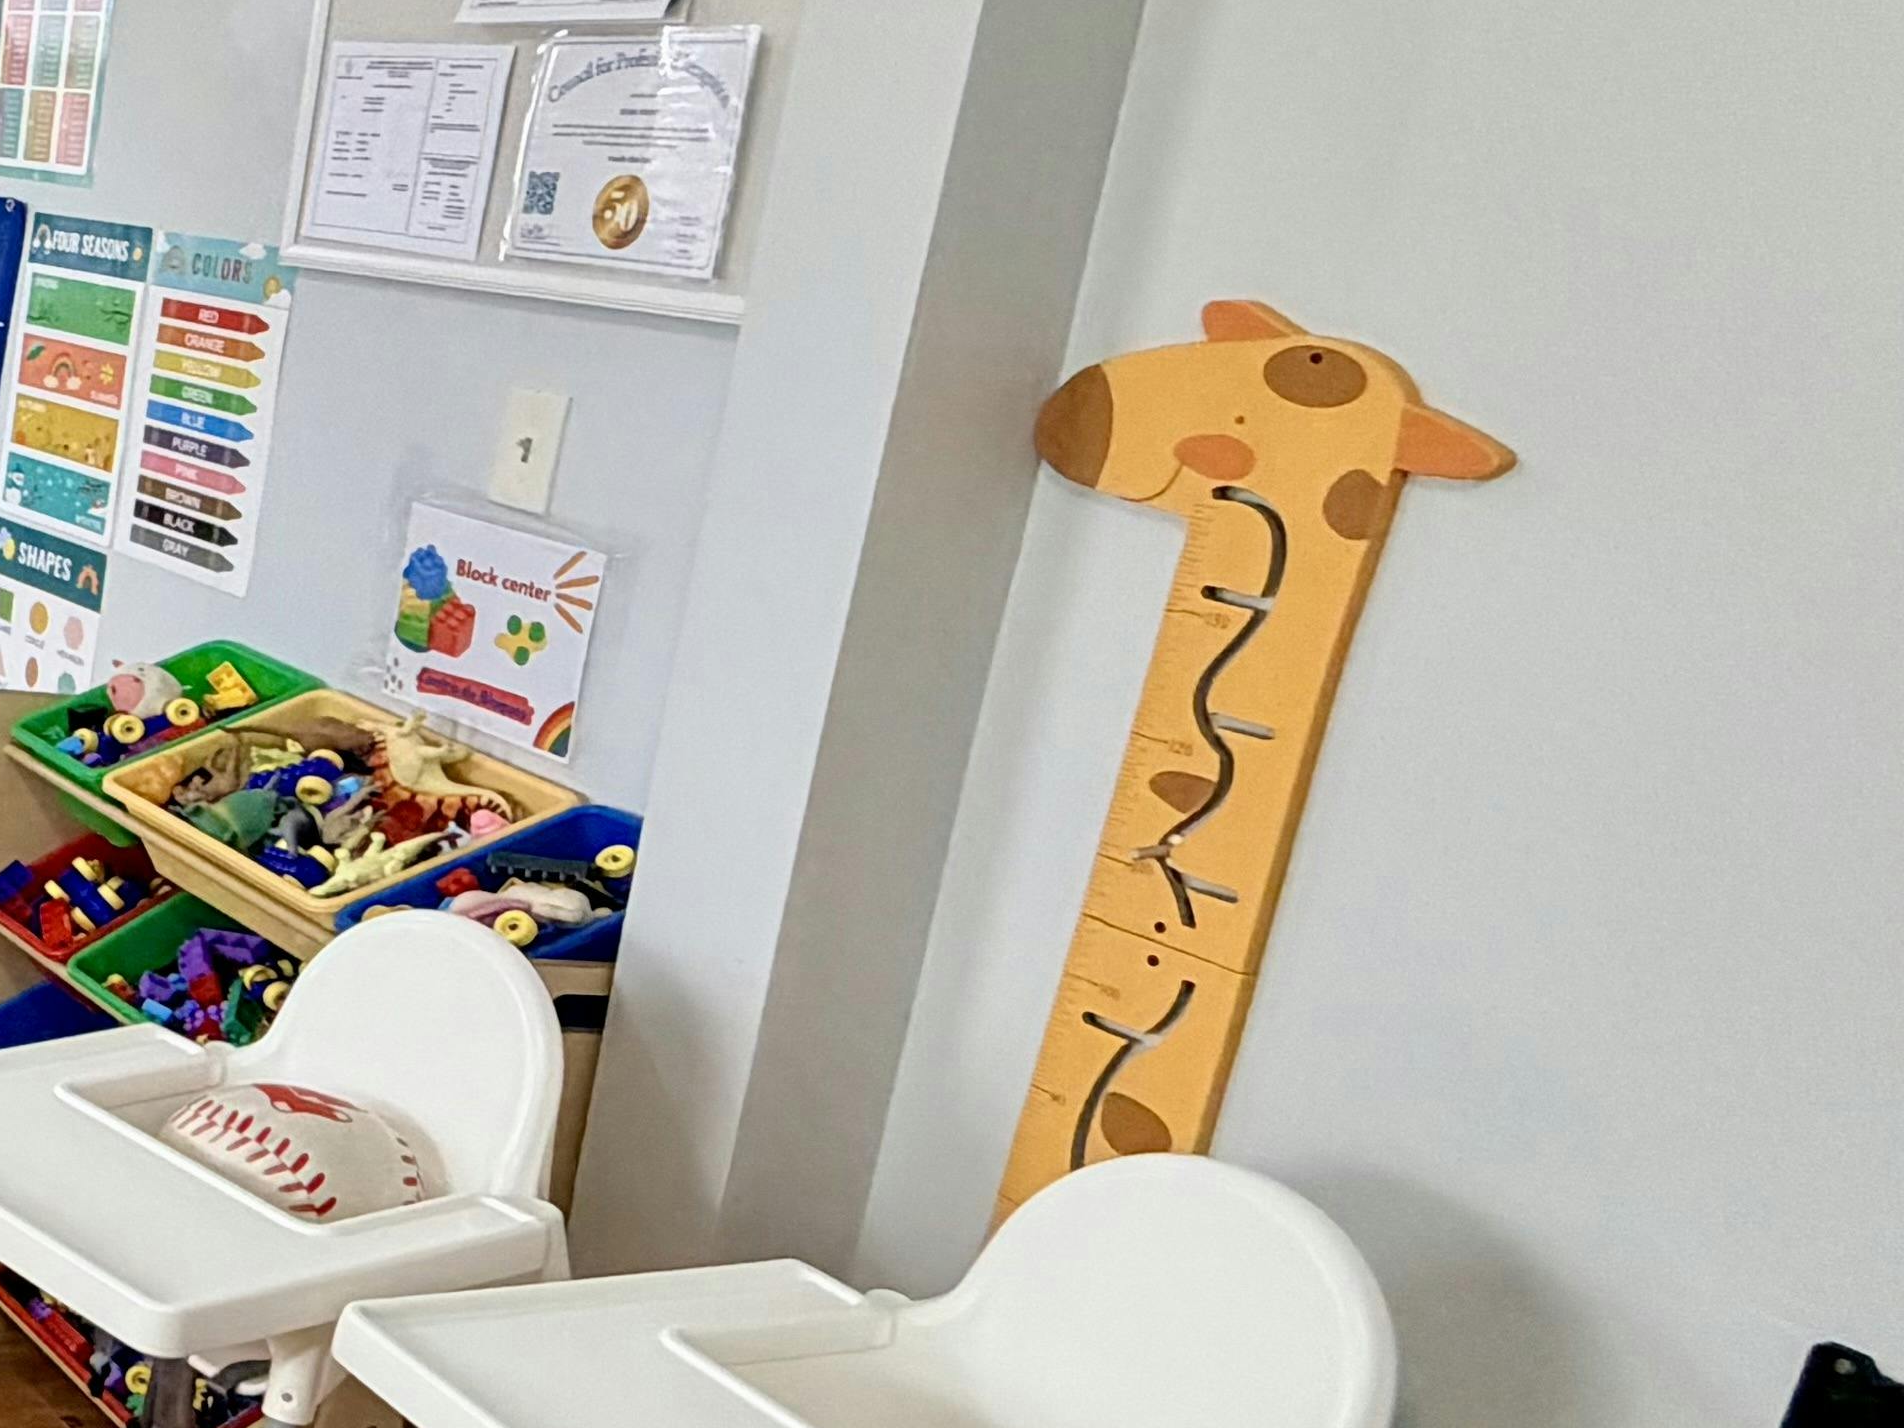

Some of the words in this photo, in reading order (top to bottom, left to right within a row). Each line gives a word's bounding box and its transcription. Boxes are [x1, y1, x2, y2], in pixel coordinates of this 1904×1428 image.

[52, 230, 81, 253] FOUR
[81, 233, 130, 262] SEASONS
[192, 252, 253, 284] COLORS
[198, 308, 219, 323] RED
[184, 332, 225, 353] ORANGE
[181, 385, 213, 404] GREEN
[172, 436, 208, 457] PURPLE
[165, 487, 201, 509] BROWN
[163, 513, 196, 534] BLACK
[162, 539, 189, 557] GRAY
[17, 541, 73, 582] SHAPES
[456, 558, 499, 586] Block
[501, 576, 552, 602] center
